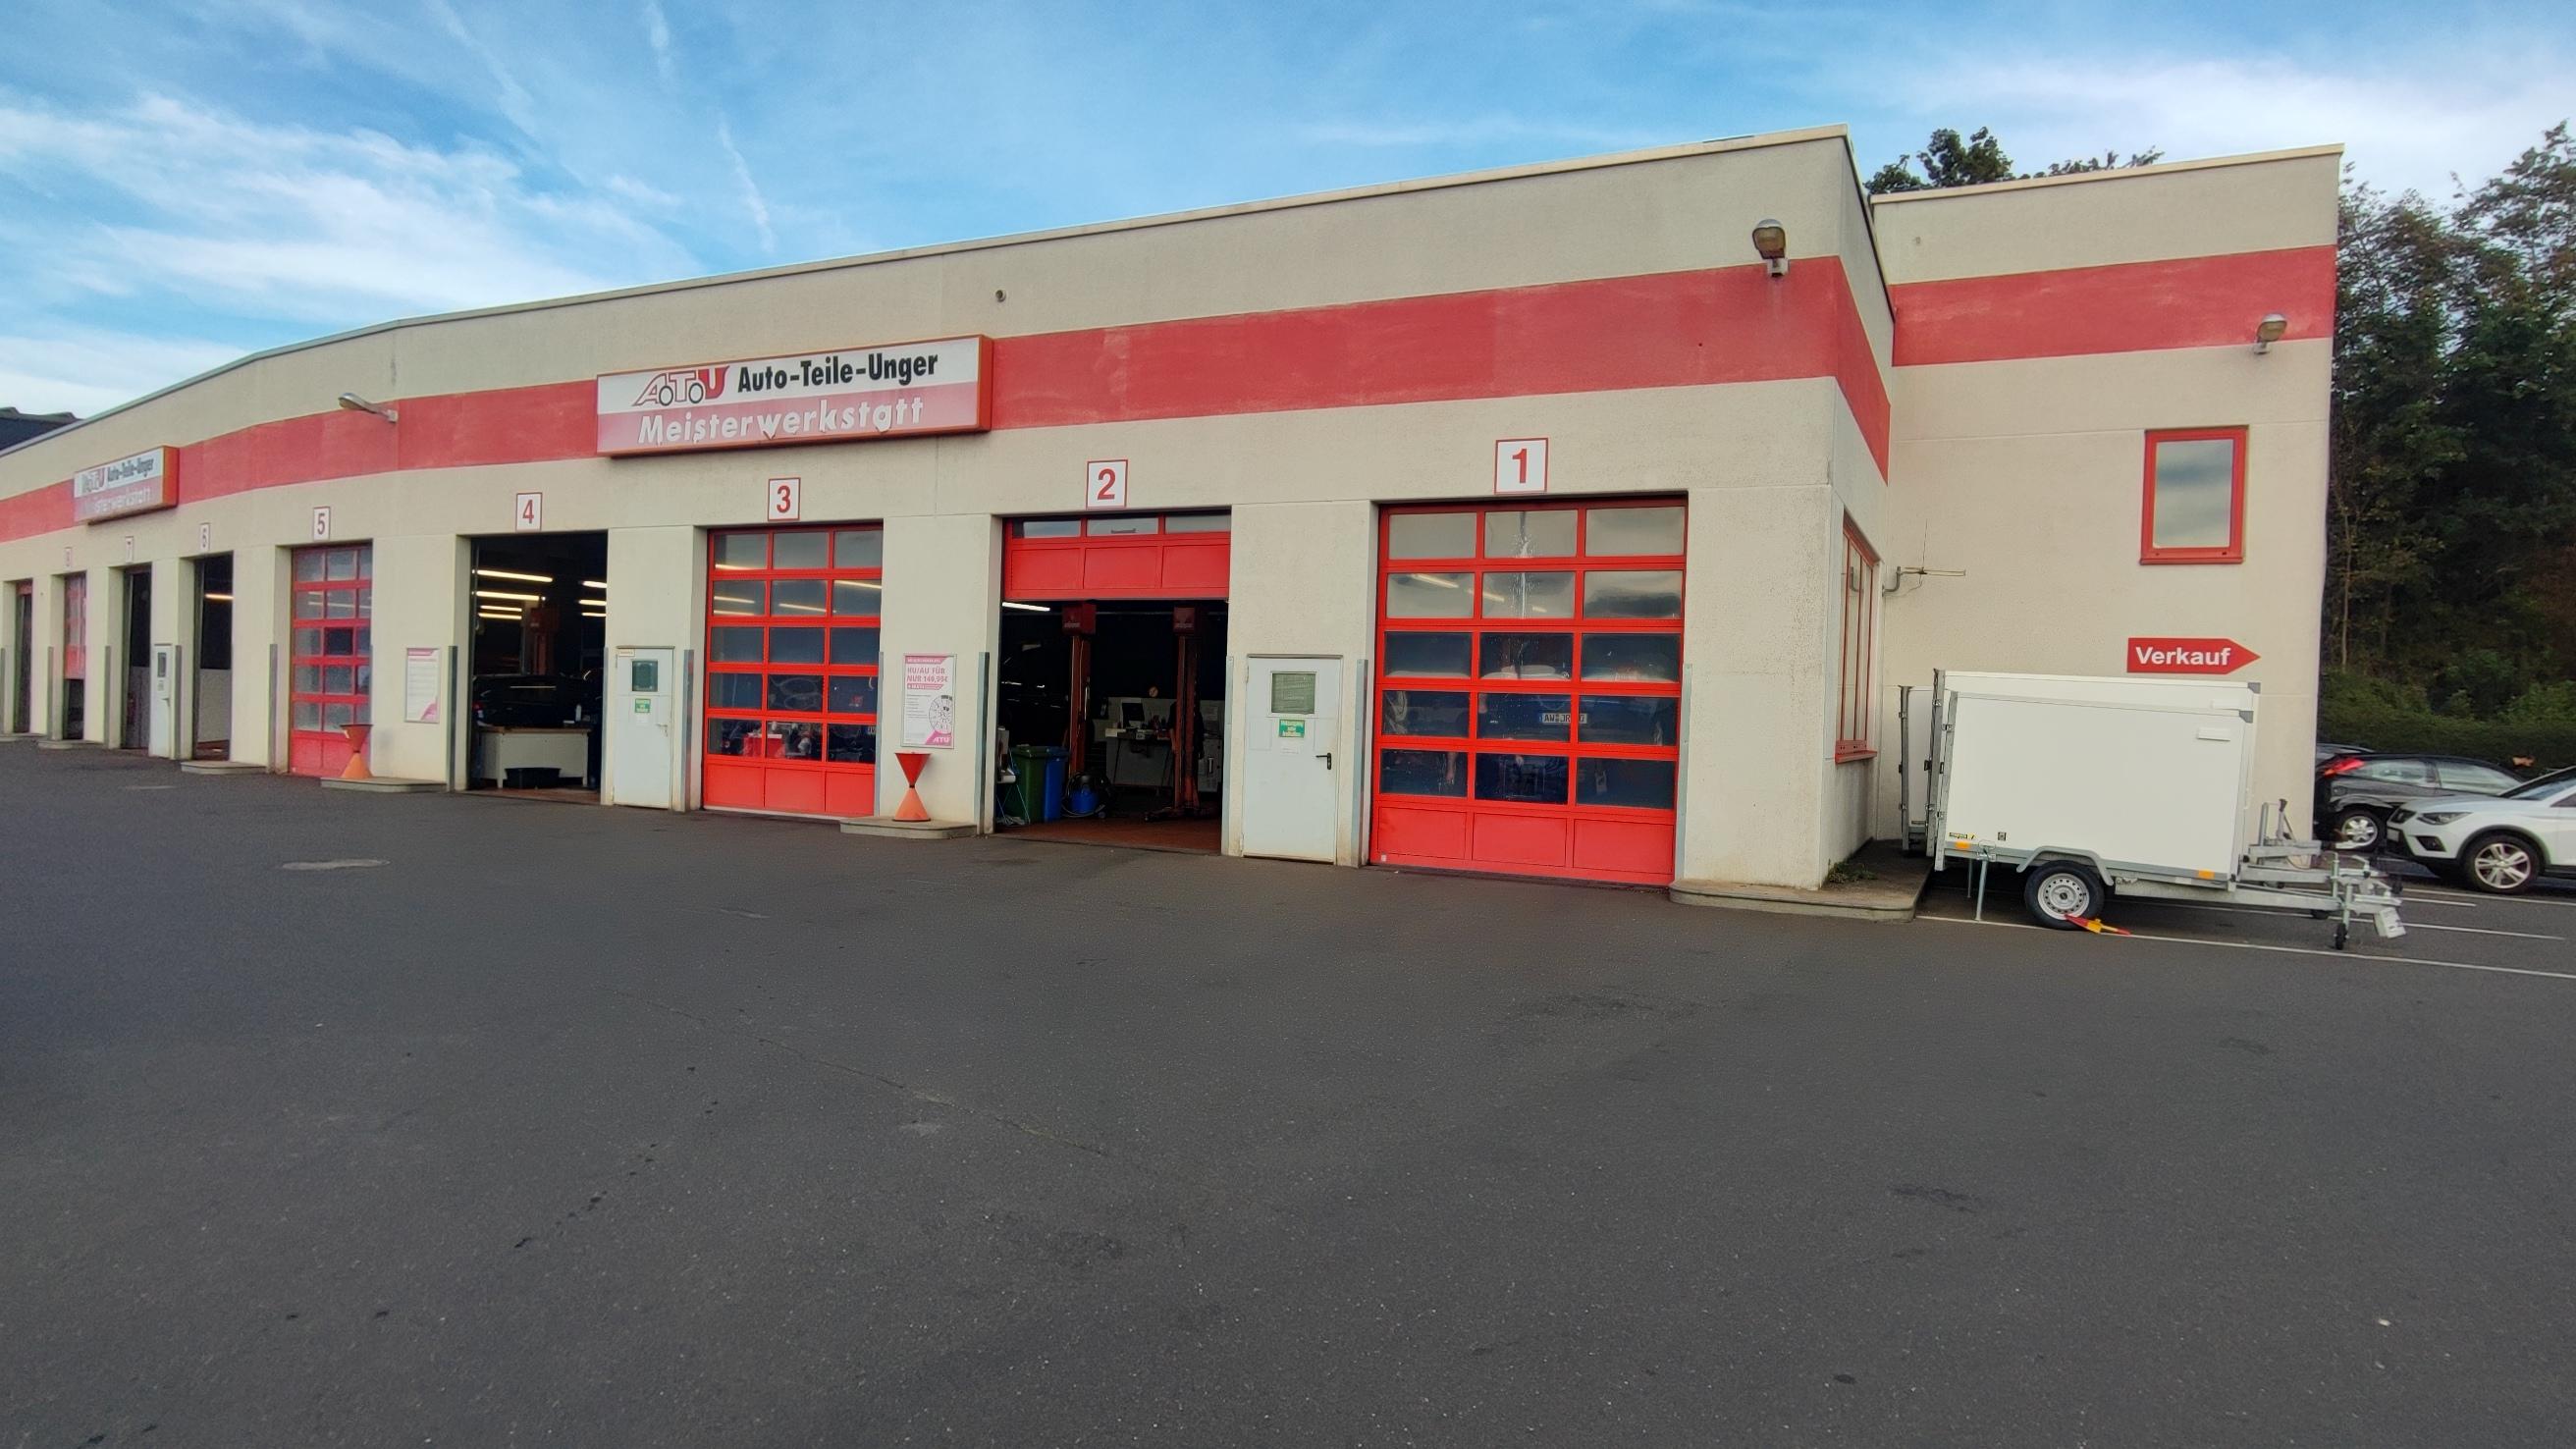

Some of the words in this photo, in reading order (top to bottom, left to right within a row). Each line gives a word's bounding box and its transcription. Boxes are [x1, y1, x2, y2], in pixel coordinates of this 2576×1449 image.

[631, 364, 730, 406] ATU
[737, 351, 939, 394] Auto-Teile-Unger
[637, 397, 924, 445] Meisterwerkstatt
[1512, 448, 1527, 484] 1
[777, 485, 791, 513] 3
[1097, 468, 1116, 501] 2
[317, 512, 326, 535] 5
[522, 499, 535, 524] 4
[2135, 646, 2231, 666] Verkauf
